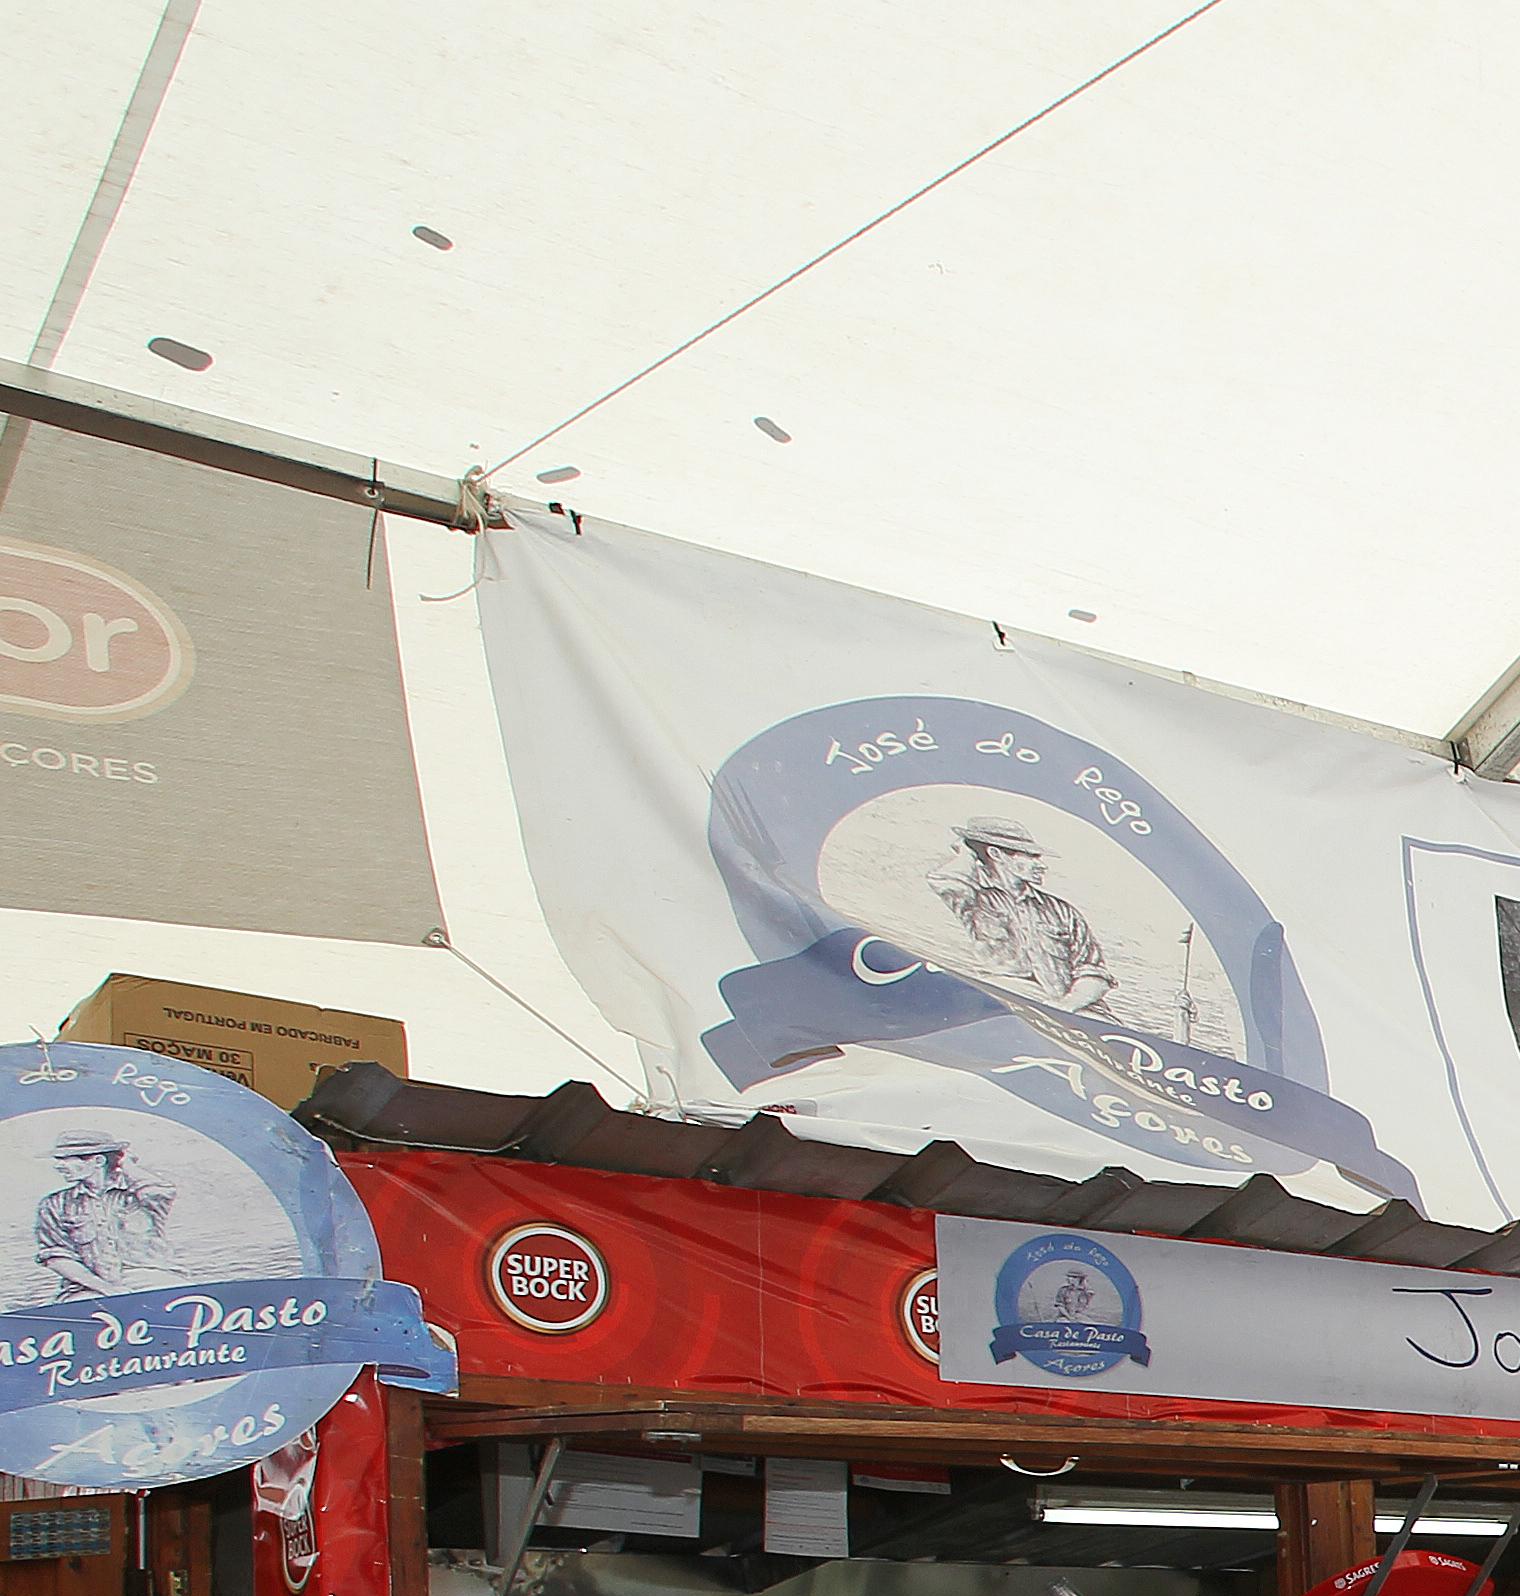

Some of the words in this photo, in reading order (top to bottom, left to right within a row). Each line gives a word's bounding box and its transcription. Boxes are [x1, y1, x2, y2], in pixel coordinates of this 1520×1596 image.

[825, 718, 940, 775] José
[974, 733, 1042, 764] do
[1074, 766, 1154, 837] Rego
[162, 1007, 247, 1031] PORTUGAL
[250, 1022, 273, 1035] EM
[276, 1026, 360, 1050] FABRICADO
[219, 1051, 241, 1065] 30
[111, 1062, 192, 1107] Rego
[1101, 1034, 1274, 1112] Pasto
[992, 1055, 1255, 1165] Açores
[506, 1253, 591, 1283] SUPER
[510, 1275, 588, 1303] BOCK
[91, 1312, 154, 1351] de
[164, 1295, 328, 1349] Pasto
[1019, 1324, 1060, 1340] Casa
[1063, 1326, 1080, 1339] de
[1083, 1326, 1126, 1343] Pasto
[38, 1342, 248, 1397] Restaurante
[1043, 1357, 1106, 1375] Açores
[1345, 1561, 1382, 1586] SAGRE
